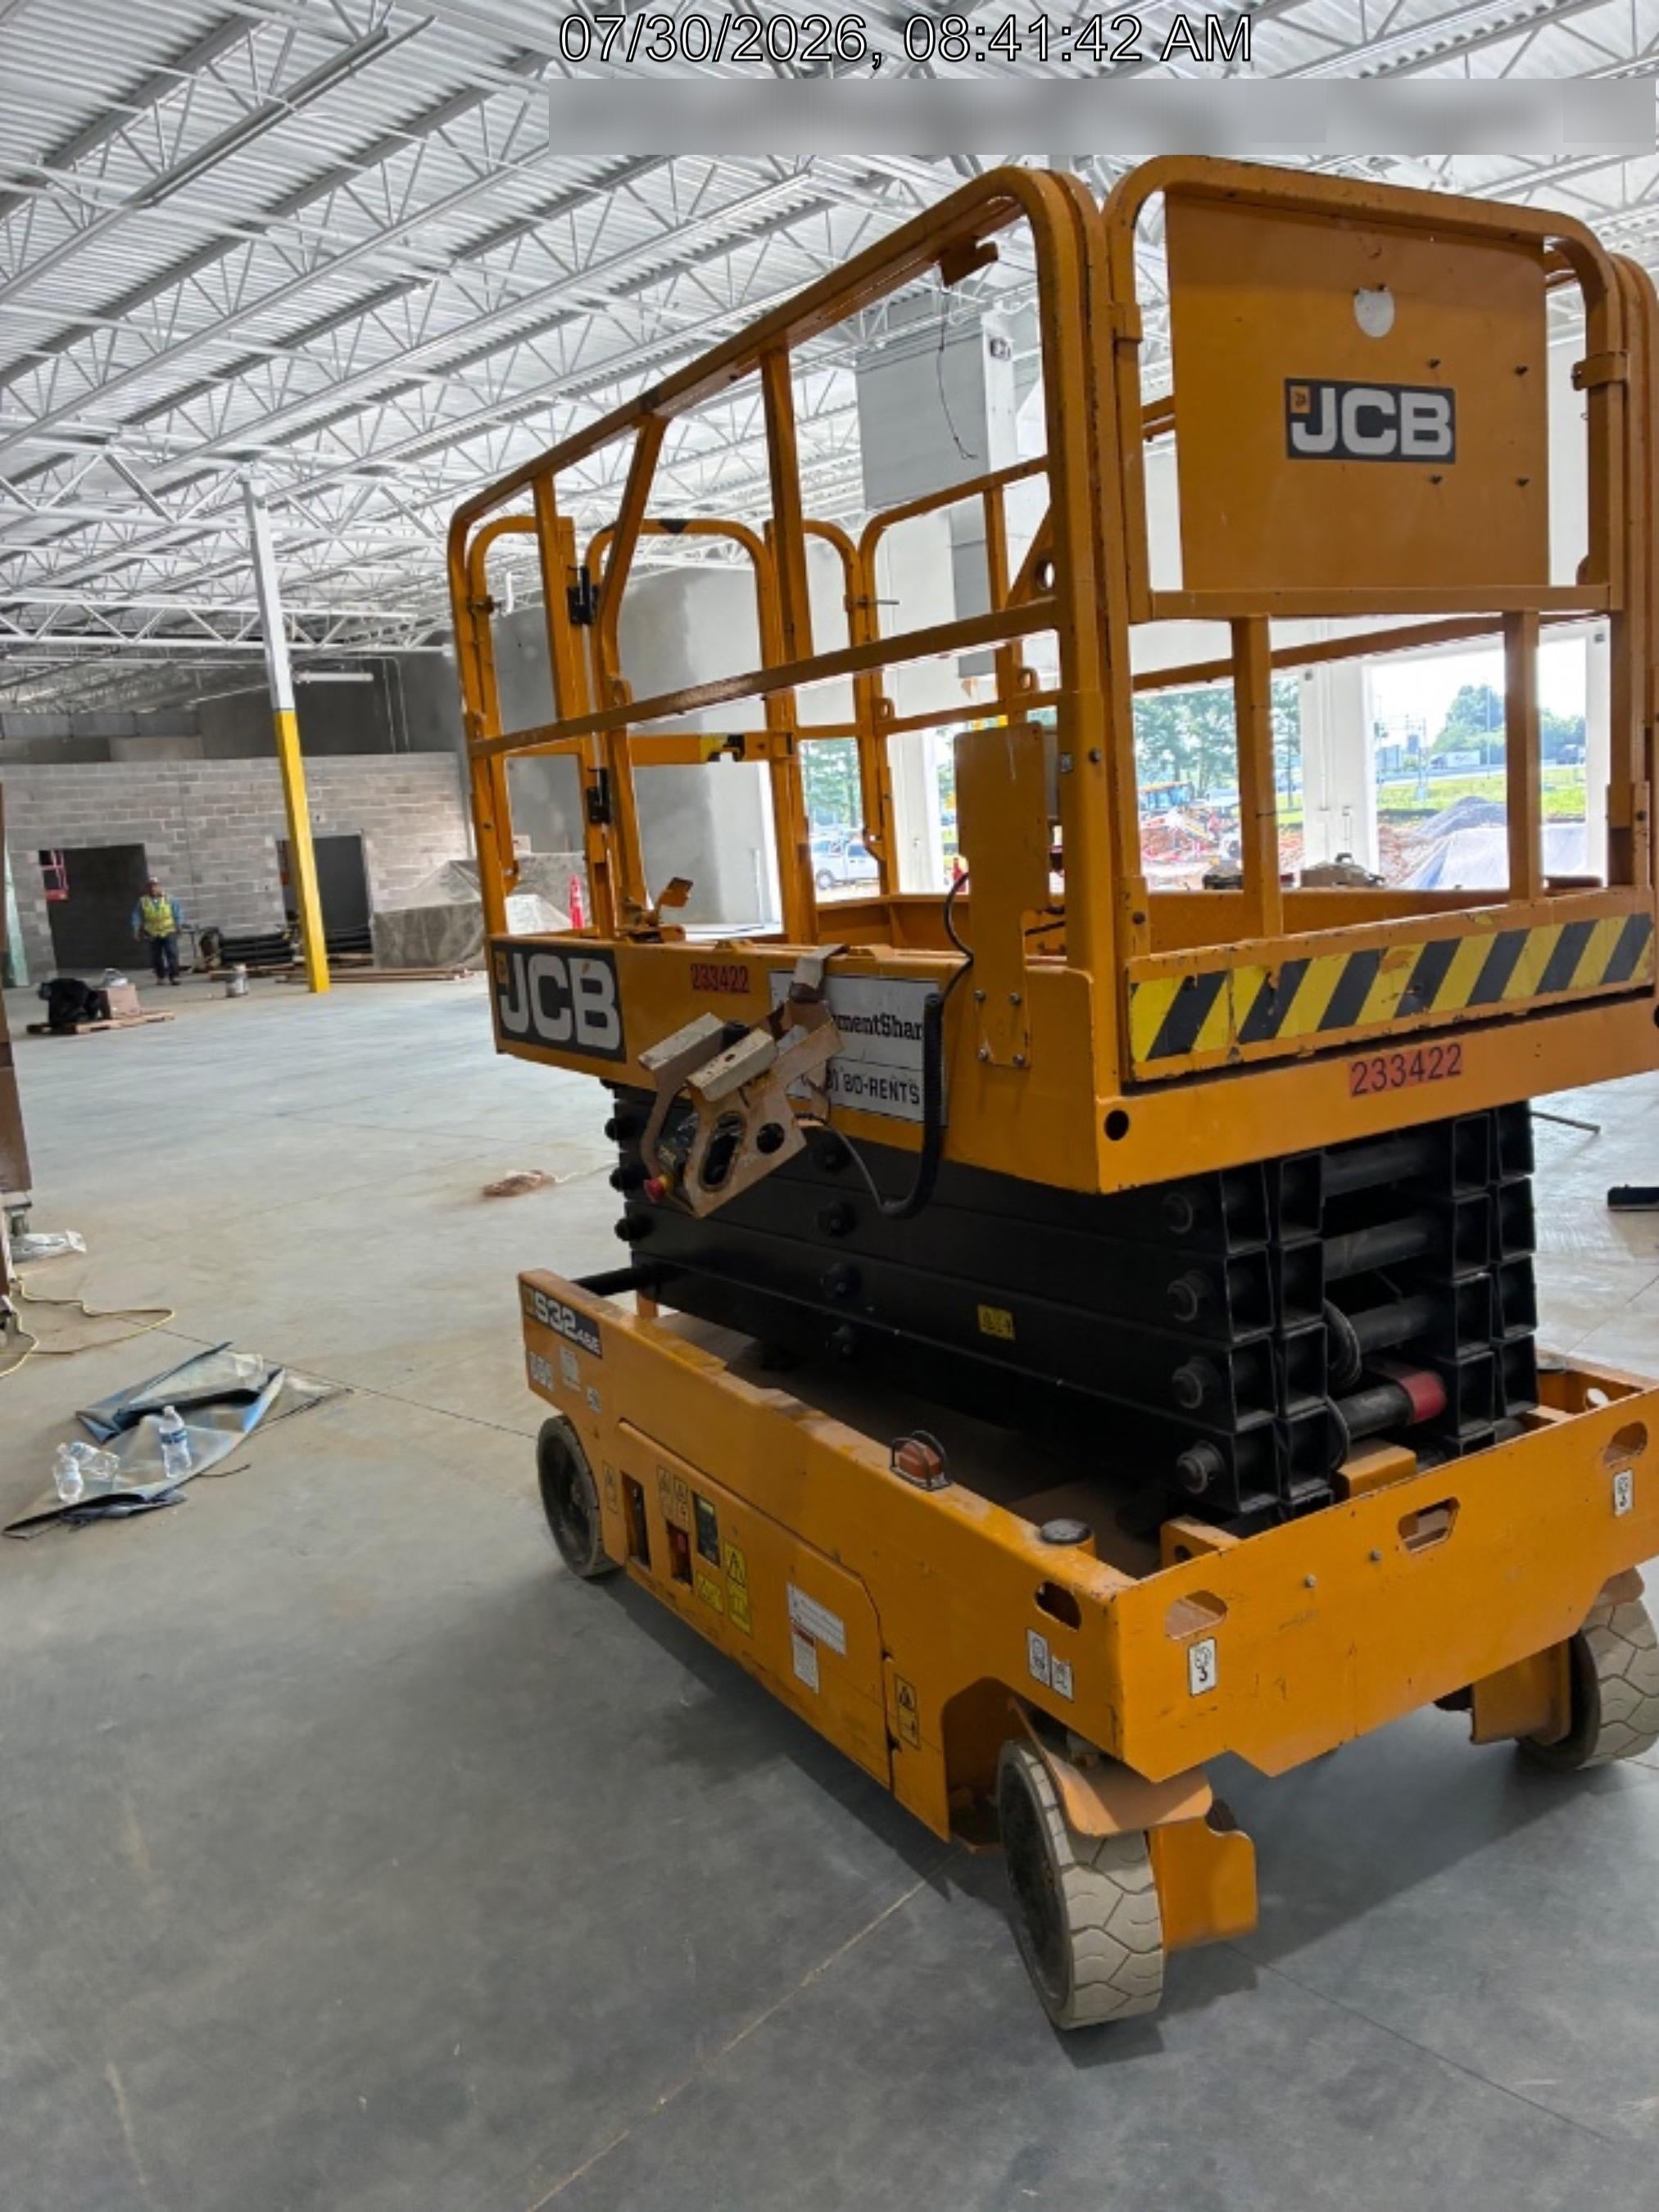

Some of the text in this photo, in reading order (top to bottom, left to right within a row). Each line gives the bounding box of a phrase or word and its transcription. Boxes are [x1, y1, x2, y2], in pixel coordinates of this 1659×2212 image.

[1291, 388, 1453, 456] JCB
[500, 953, 620, 1050] JCB
[691, 963, 750, 993] 233422
[832, 1013, 922, 1041] mentShar
[1351, 1042, 1462, 1096] 233422
